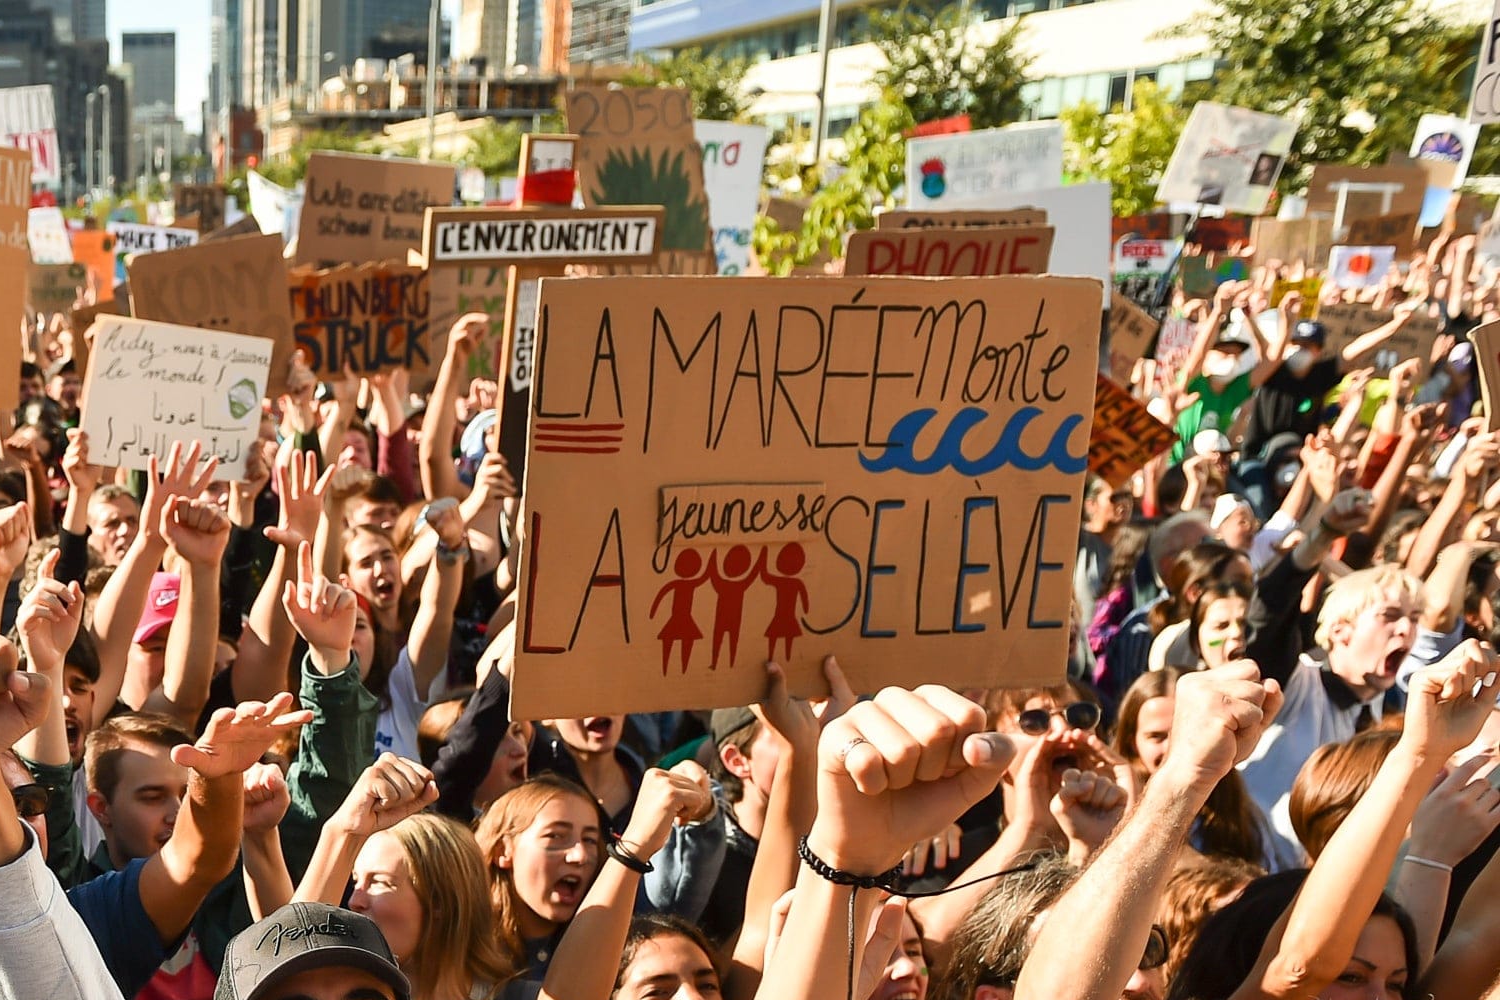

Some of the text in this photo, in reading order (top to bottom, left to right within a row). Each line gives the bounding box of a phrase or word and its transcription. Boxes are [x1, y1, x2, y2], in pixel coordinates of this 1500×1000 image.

[310, 178, 353, 209] We
[442, 220, 650, 255] L'ENVIRONEMENT
[295, 320, 430, 373] STRUCK
[534, 304, 624, 420] LA
[644, 288, 924, 453] MARÉE
[652, 490, 827, 573] jeunesse
[524, 507, 631, 654] LA
[255, 912, 360, 957] Fender
